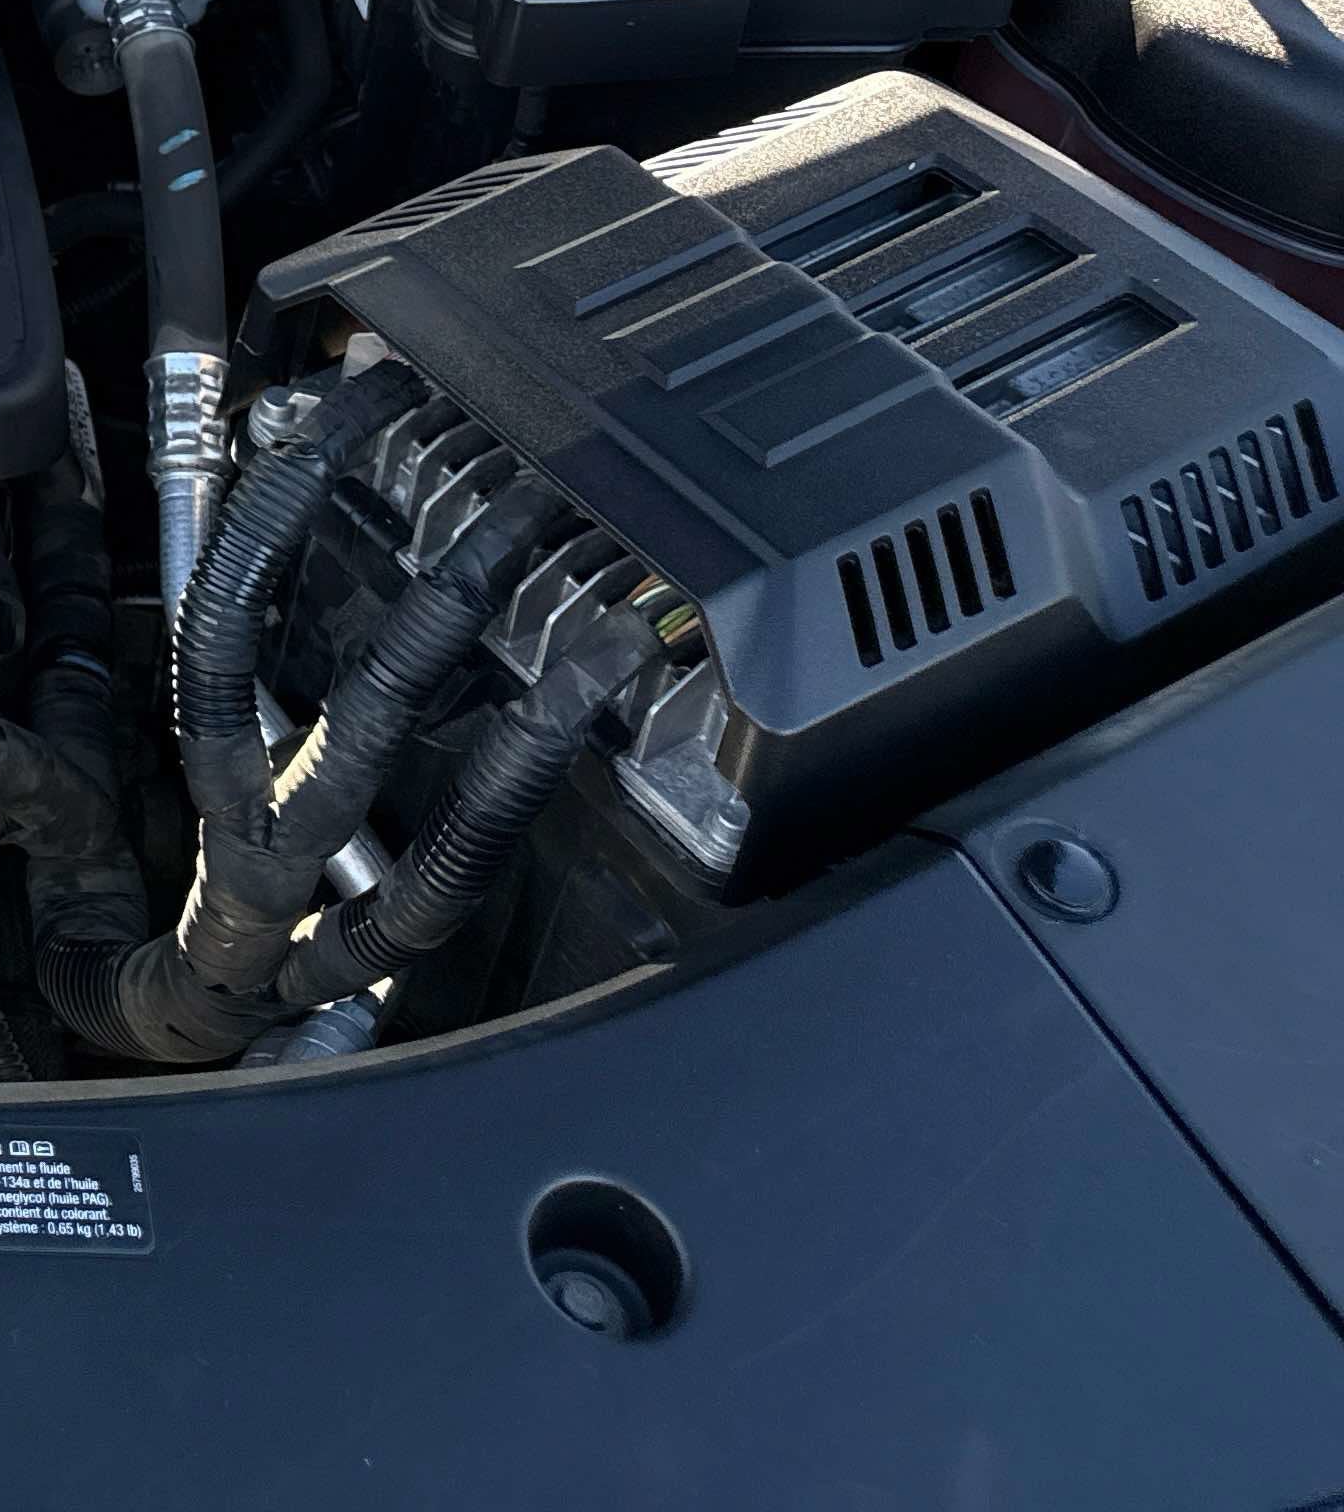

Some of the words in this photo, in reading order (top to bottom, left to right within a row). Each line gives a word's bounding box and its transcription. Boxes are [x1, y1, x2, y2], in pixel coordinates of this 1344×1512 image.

[26, 1161, 36, 1174] le
[40, 1162, 71, 1174] fluide
[34, 1178, 45, 1189] et
[48, 1177, 61, 1189] de
[49, 1192, 79, 1205] (huile
[44, 1207, 58, 1219] du
[61, 1208, 110, 1220] colorant.
[48, 1222, 74, 1235] 0,65
[77, 1223, 92, 1237] kg
[95, 1224, 123, 1237] (1,43
[127, 1224, 142, 1238] lb)
